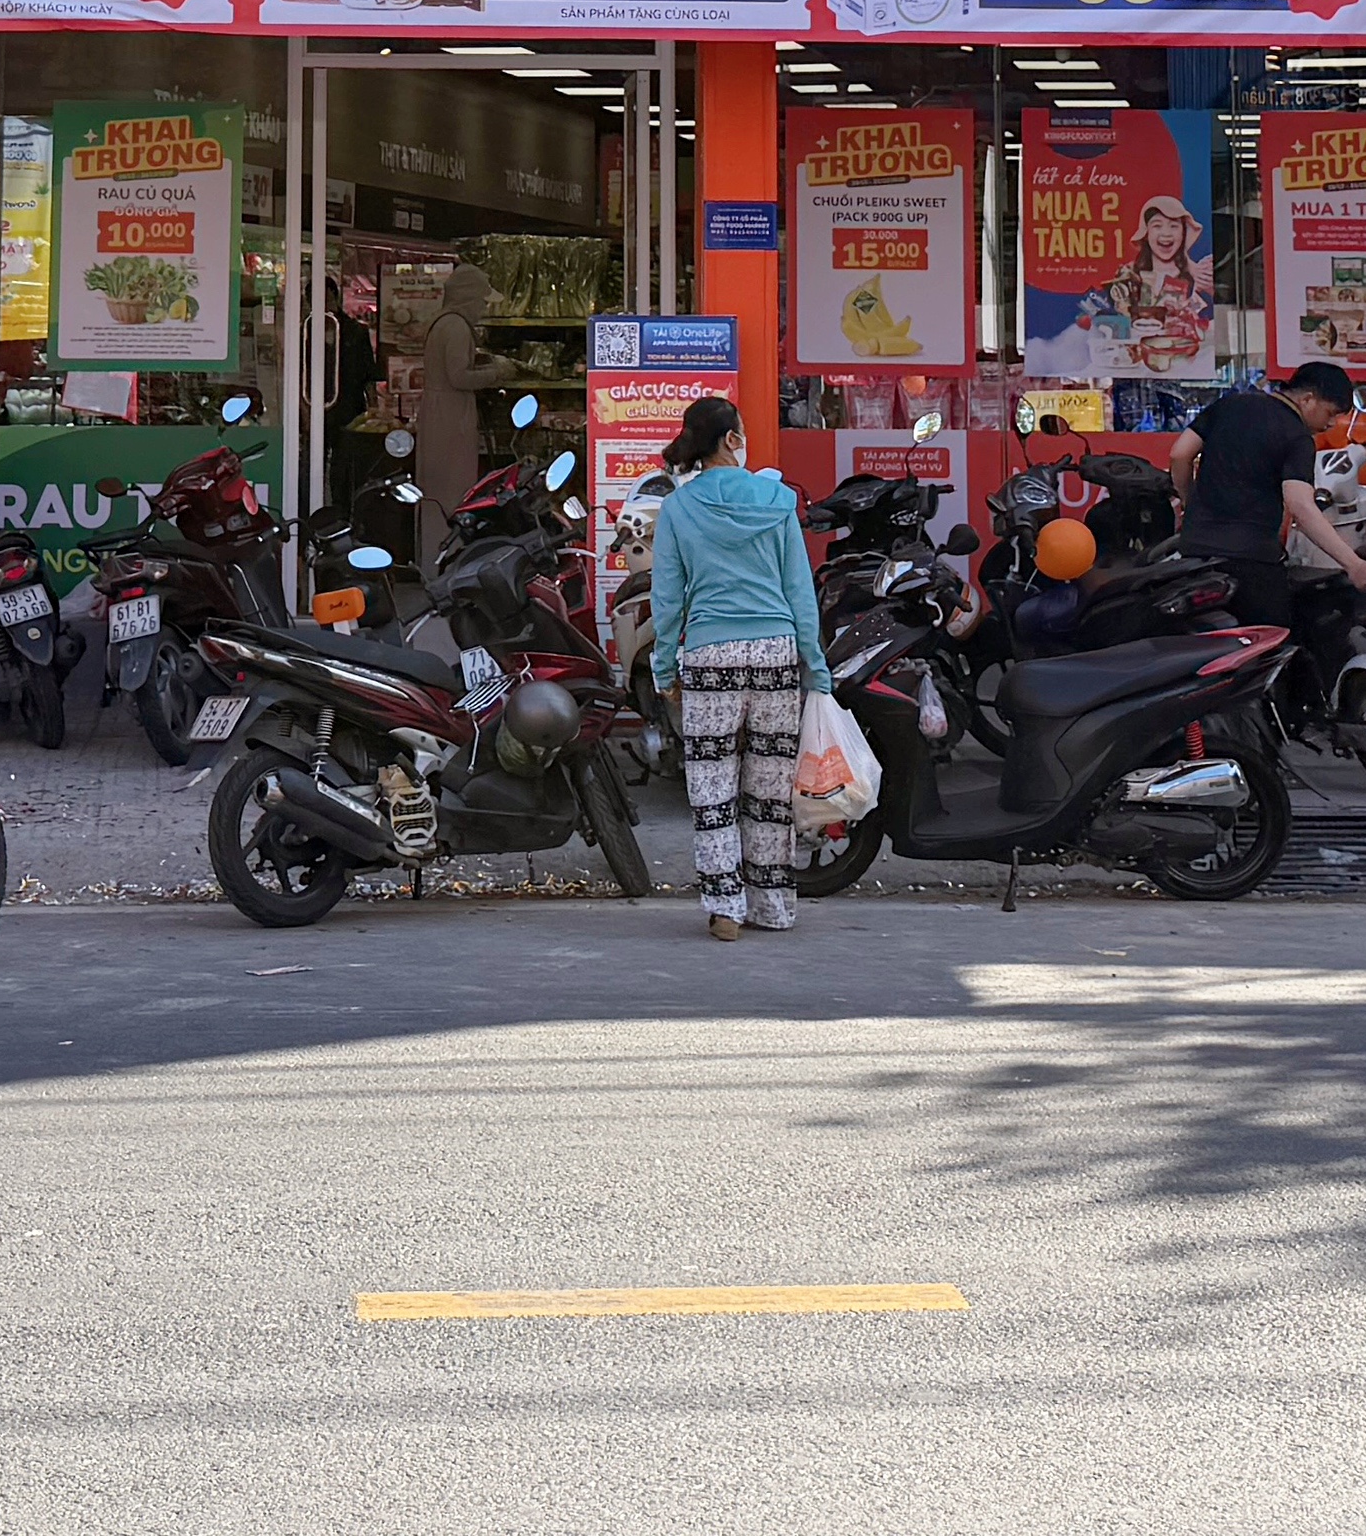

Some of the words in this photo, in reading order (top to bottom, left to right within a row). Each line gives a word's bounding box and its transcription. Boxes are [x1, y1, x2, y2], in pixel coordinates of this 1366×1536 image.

[561, 6, 585, 20] SẢN
[589, 6, 625, 20] PHẨM
[665, 7, 699, 20] CÙNG
[703, 9, 730, 23] LOẠI
[107, 119, 189, 146] KHAI
[841, 126, 917, 152] KHAI
[75, 140, 217, 172] TRƯƠNG
[809, 148, 948, 179] TRƯƠNG
[98, 188, 129, 200] RAU
[136, 185, 156, 201] CỦ
[162, 185, 195, 203] QUẢ
[813, 194, 852, 207] CHUỐI
[857, 197, 899, 207] PLEIKU
[904, 198, 947, 208] SWEET
[1033, 190, 1092, 221] MUA
[1102, 192, 1119, 221] 2
[1292, 202, 1334, 216] MUA
[1341, 203, 1350, 216] 1
[832, 212, 868, 224] (PACK
[873, 212, 903, 223] 900G
[907, 212, 928, 224] UP)
[1033, 221, 1104, 262] TẶNG
[1114, 229, 1123, 258] 1
[117, 600, 151, 620] 61-B1
[198, 718, 229, 737] 7509
